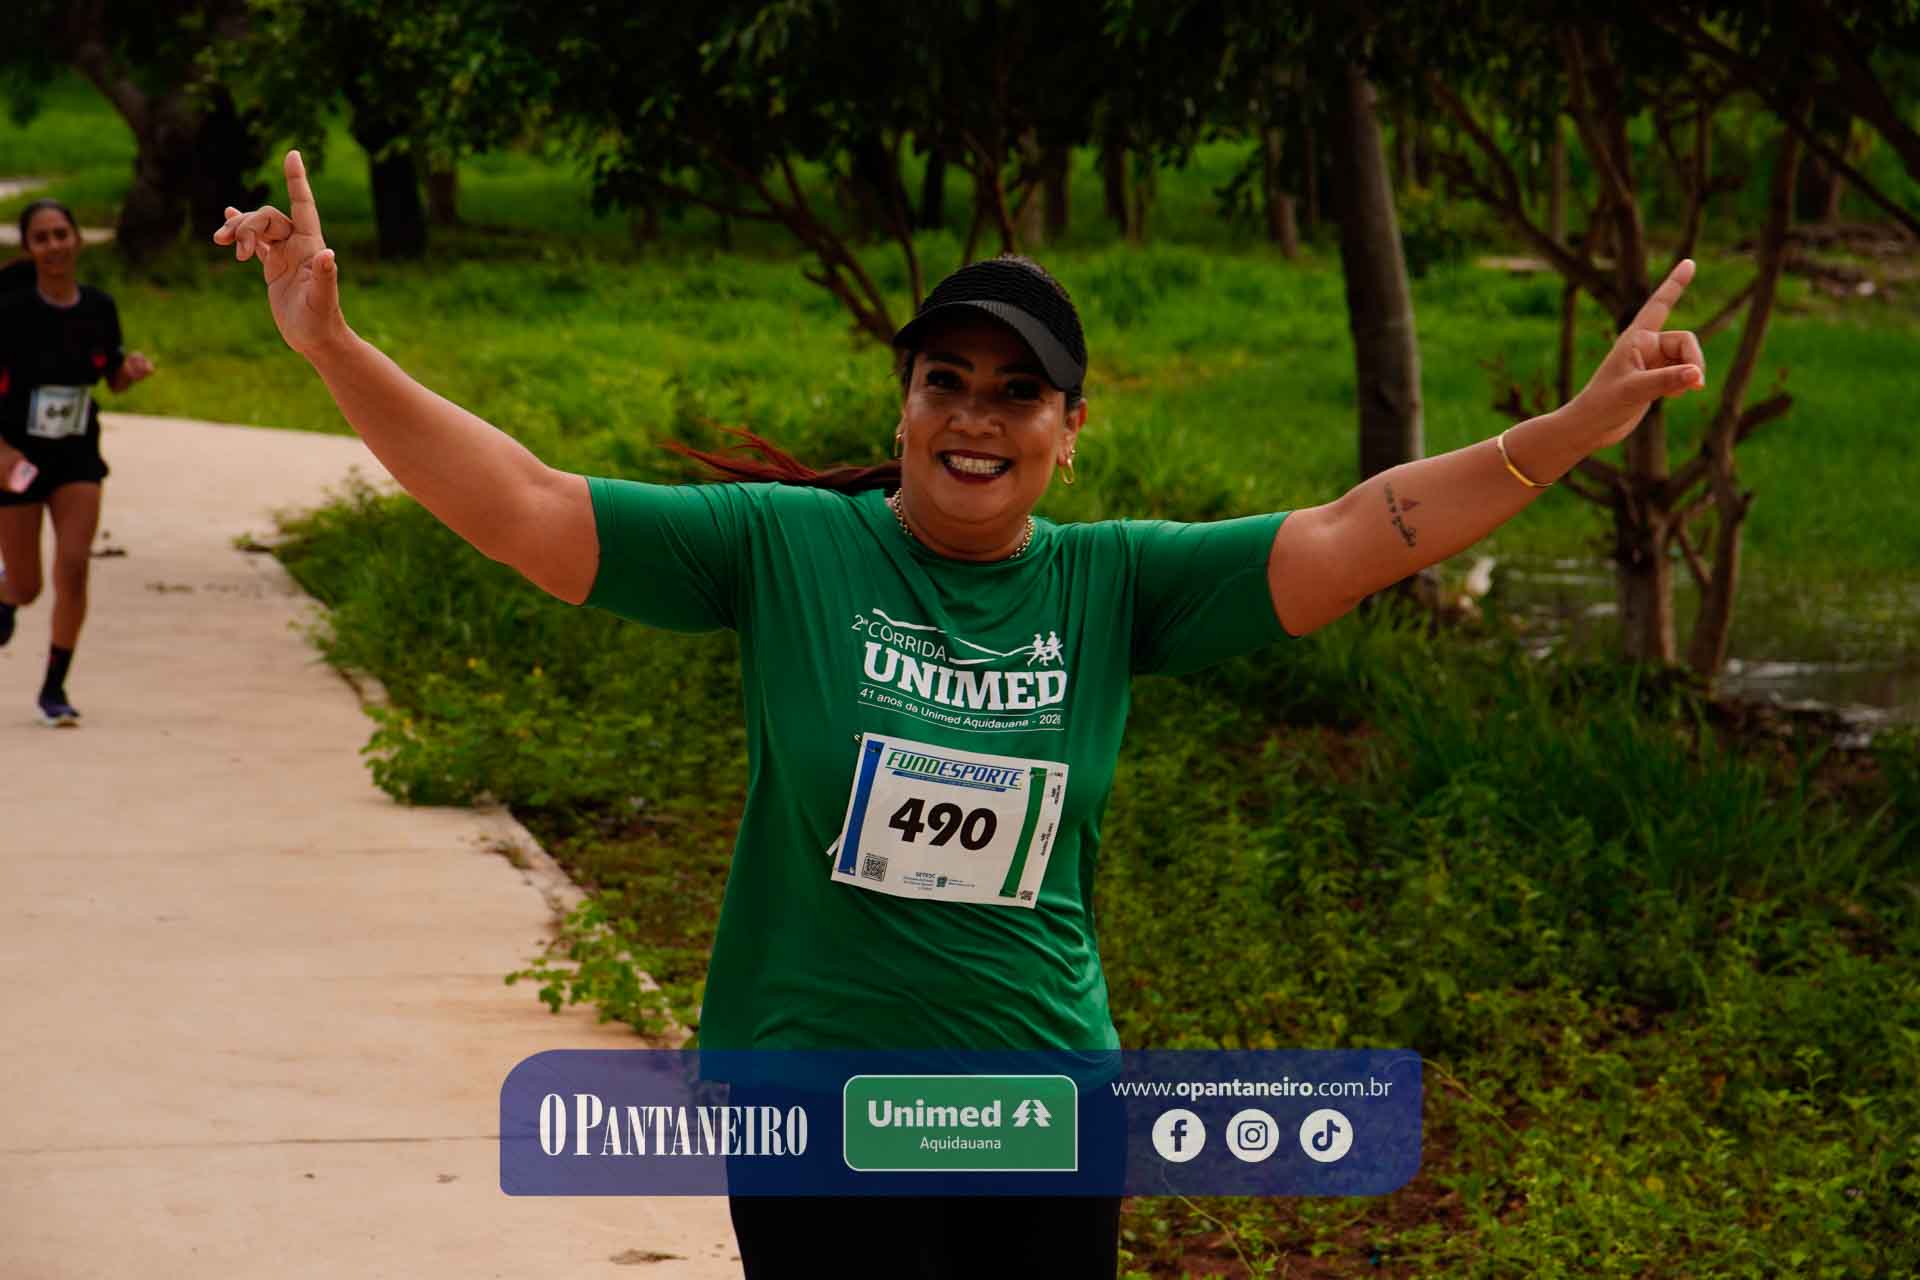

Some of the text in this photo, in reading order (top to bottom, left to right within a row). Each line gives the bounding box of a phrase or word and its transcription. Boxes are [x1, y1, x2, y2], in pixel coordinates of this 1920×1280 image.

[868, 621, 947, 661] CORRIDA
[863, 641, 1068, 711] UNIMED
[860, 688, 874, 699] 41
[877, 694, 903, 708] anos
[905, 702, 919, 713] da
[921, 707, 961, 725] Unimed
[963, 715, 1029, 730] Aquidauana
[886, 752, 1024, 788] FUNDESPORTE
[888, 797, 998, 851] 490
